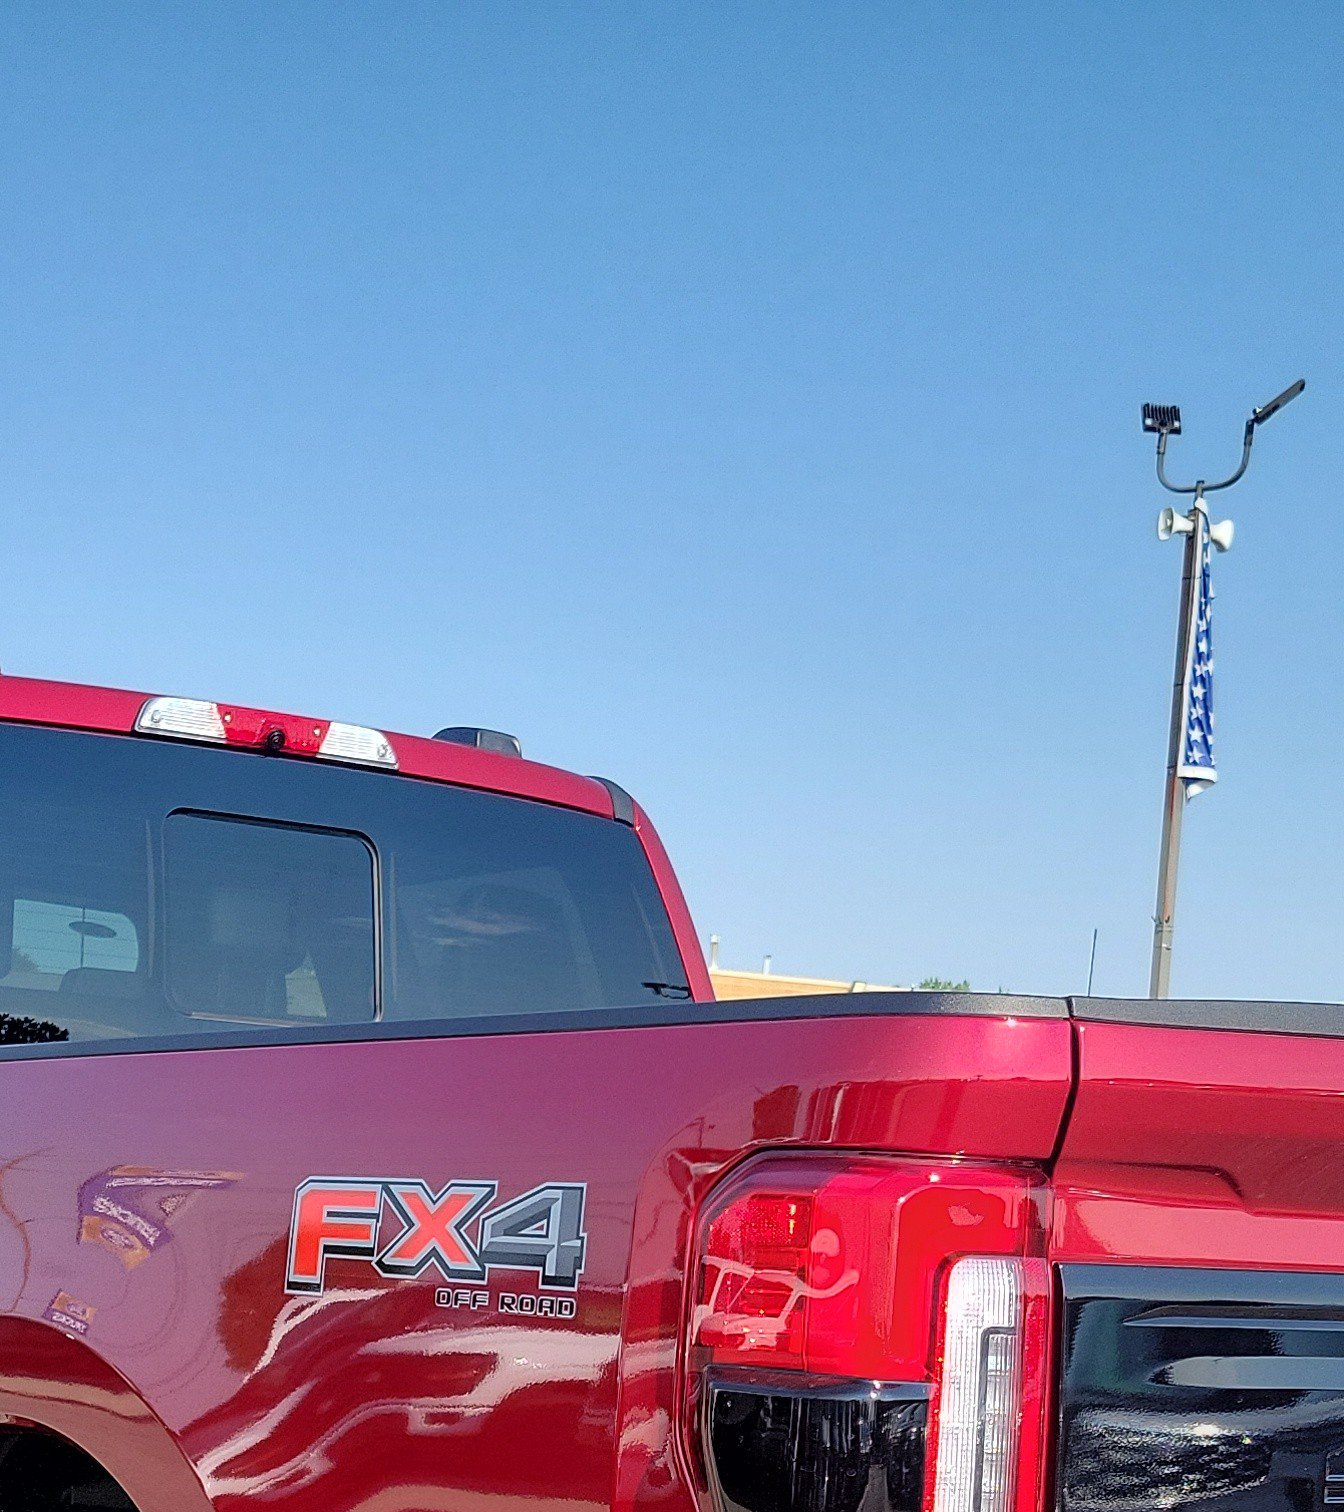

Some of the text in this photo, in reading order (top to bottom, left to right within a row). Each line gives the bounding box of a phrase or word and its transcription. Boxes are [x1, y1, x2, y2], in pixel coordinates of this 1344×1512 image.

[284, 1176, 587, 1296] FX4
[435, 1287, 577, 1319] OFF ROAD
